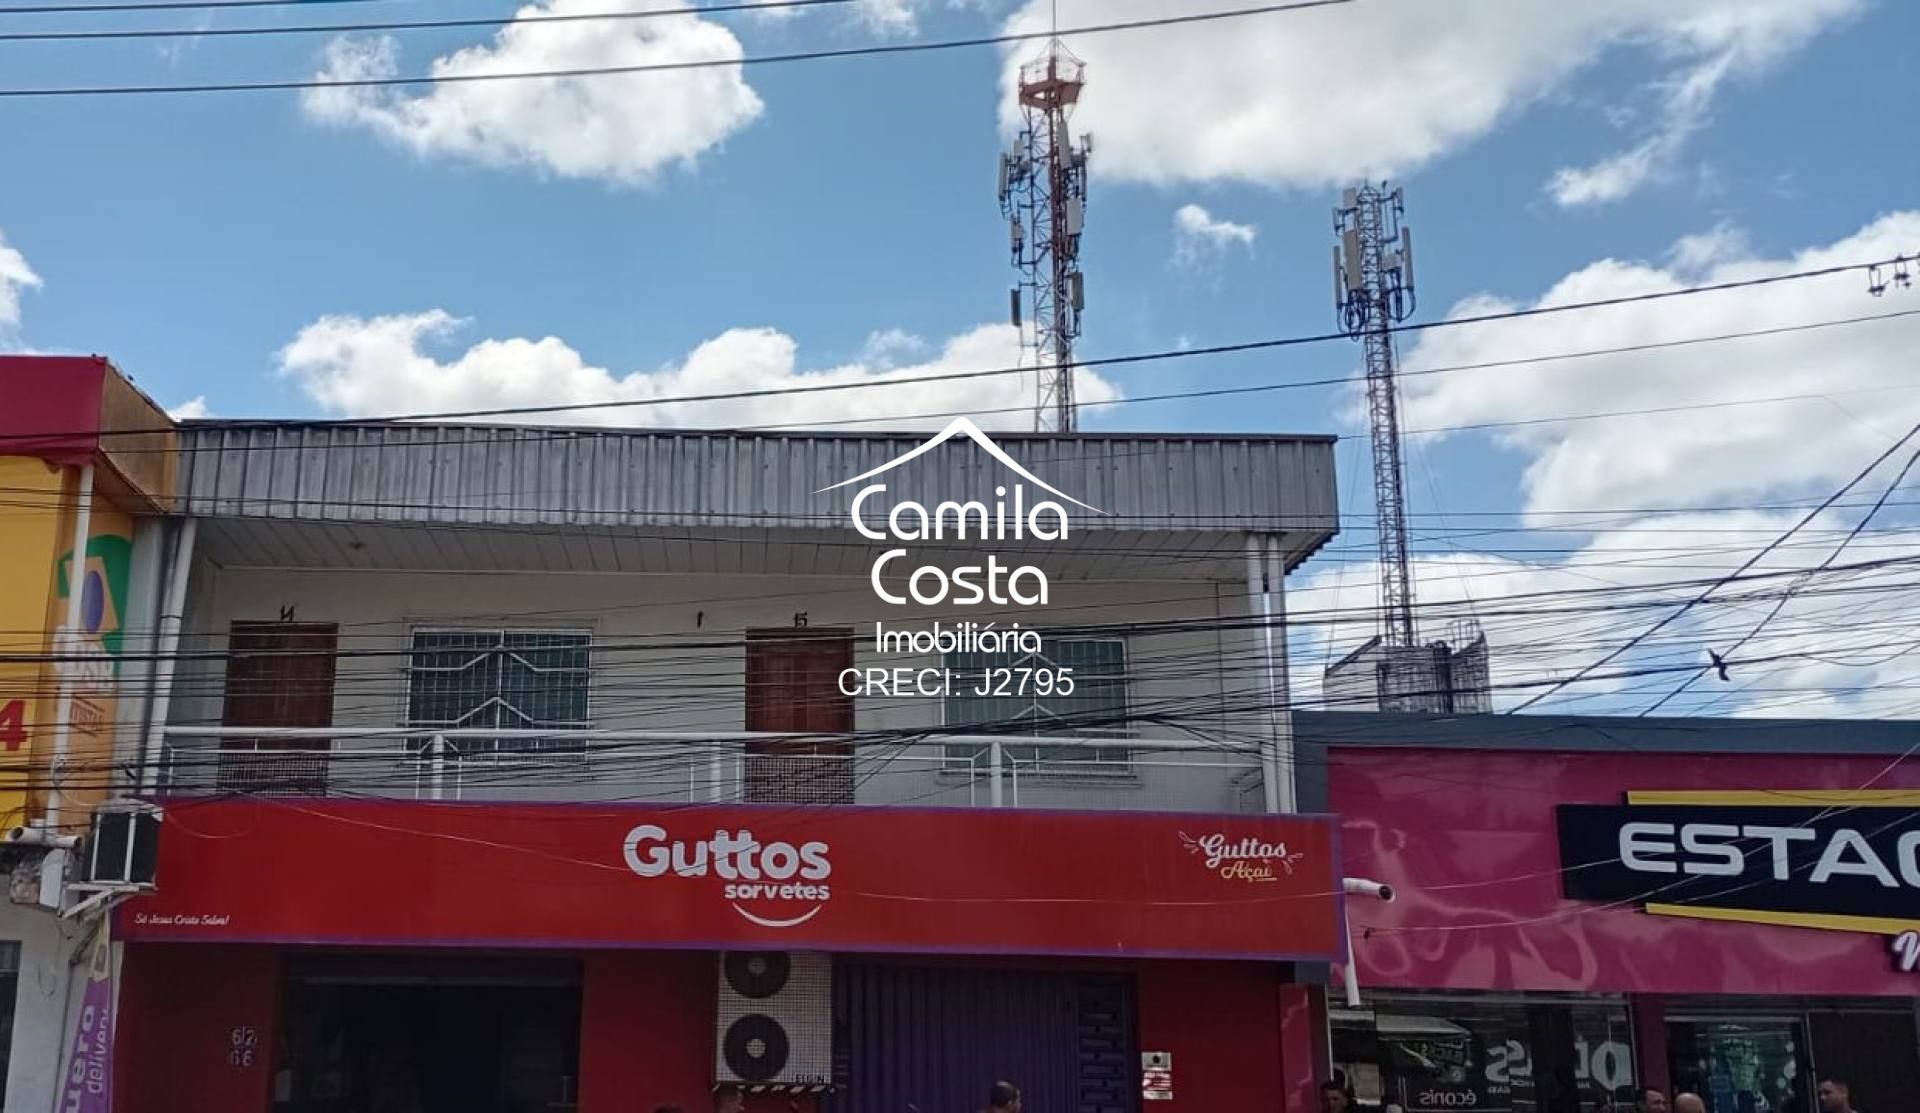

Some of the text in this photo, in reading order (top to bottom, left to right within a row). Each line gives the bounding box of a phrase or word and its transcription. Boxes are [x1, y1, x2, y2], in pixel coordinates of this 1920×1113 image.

[623, 824, 832, 880] Guttos
[1199, 833, 1287, 869] Guttos
[725, 883, 831, 901] sorvetes
